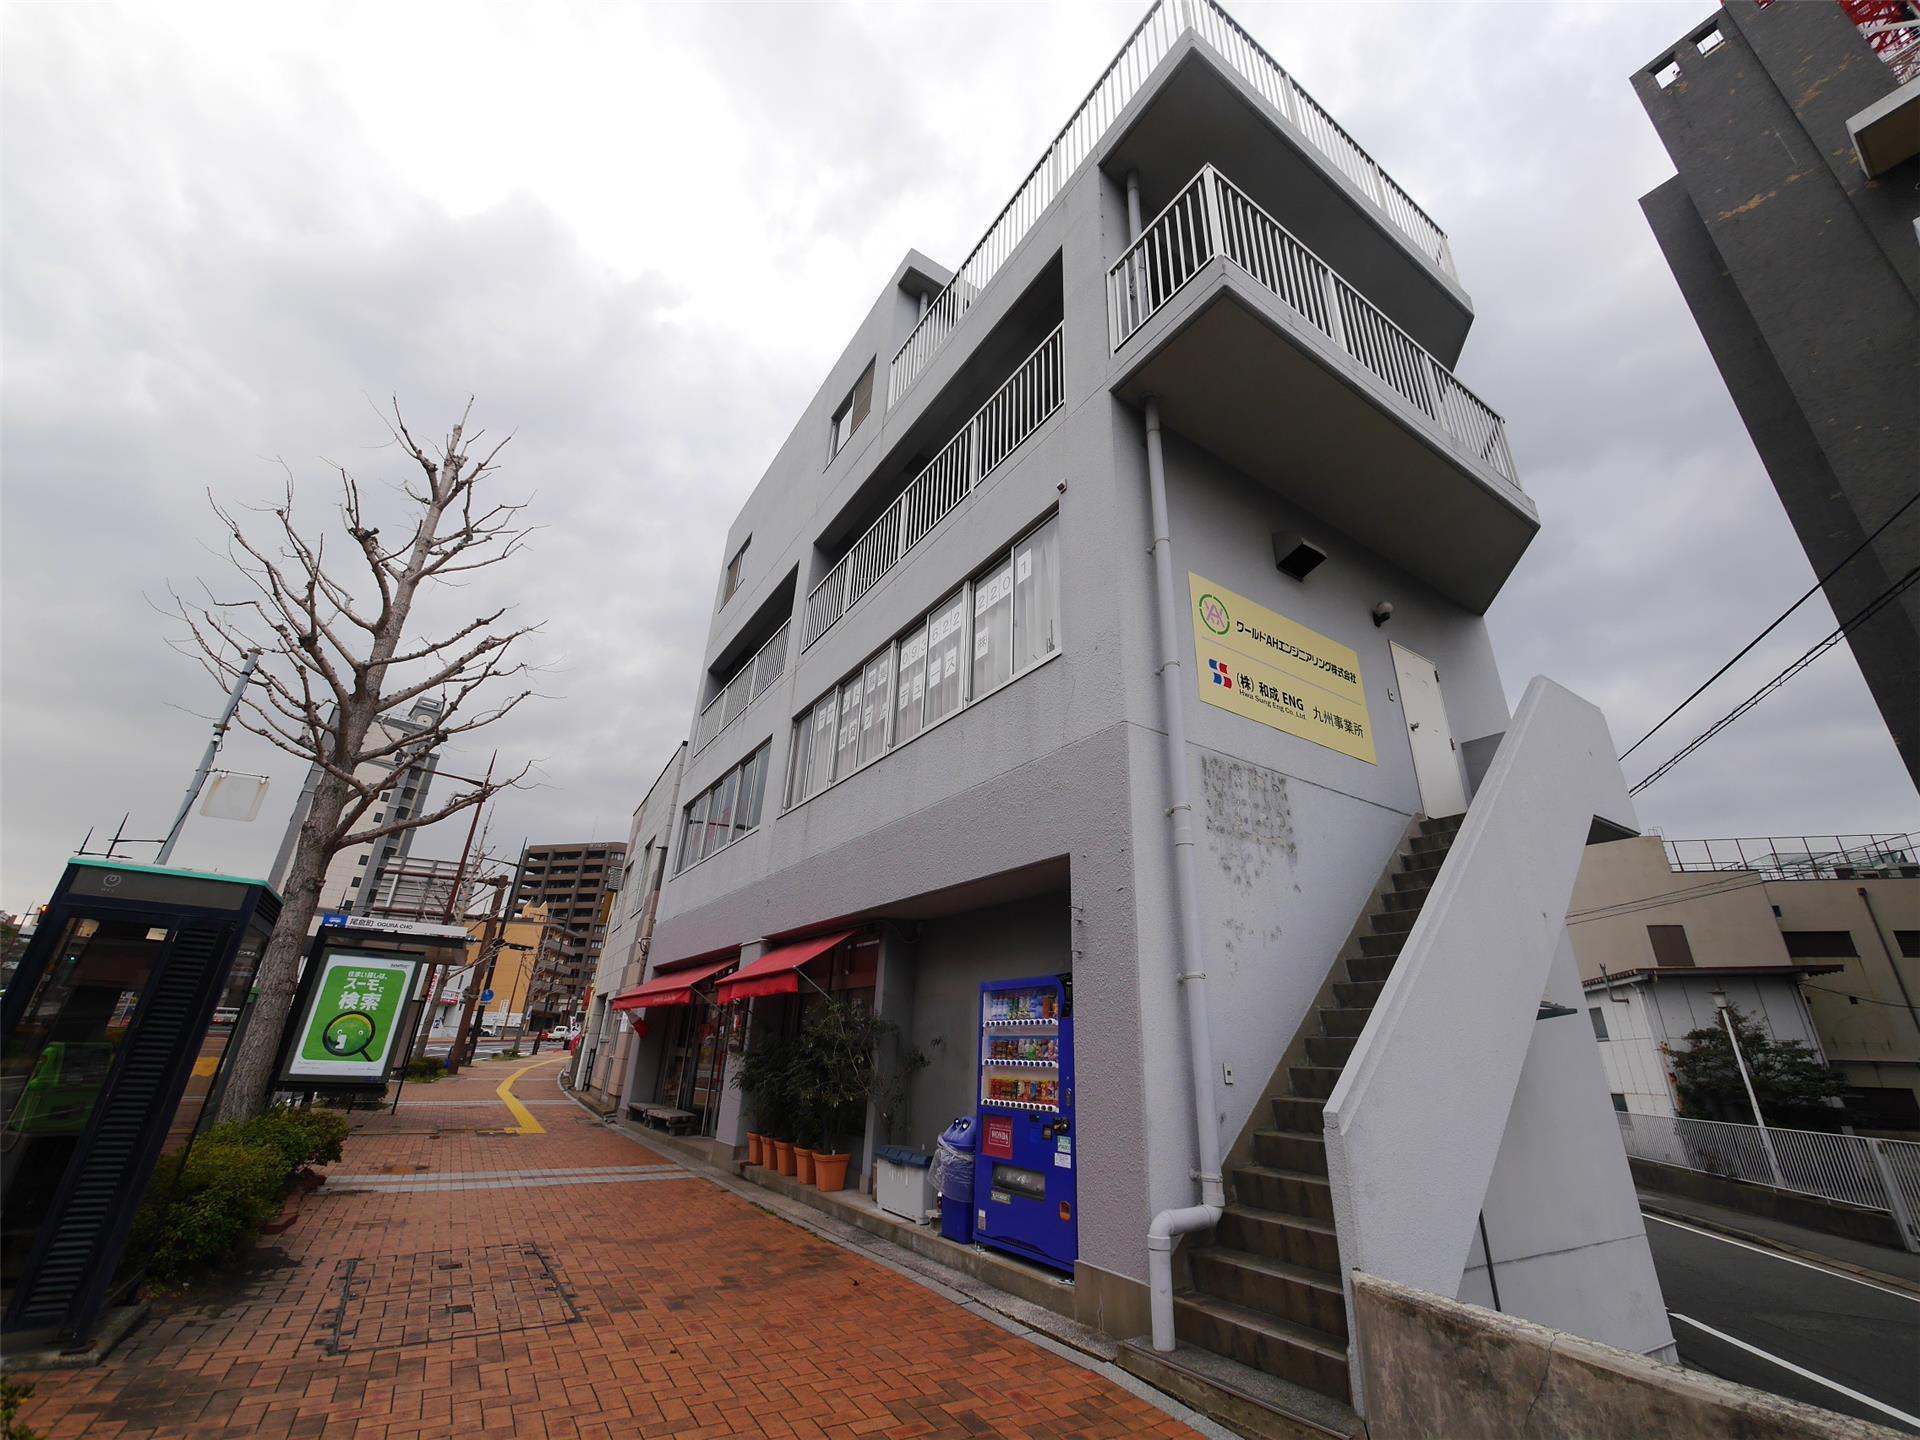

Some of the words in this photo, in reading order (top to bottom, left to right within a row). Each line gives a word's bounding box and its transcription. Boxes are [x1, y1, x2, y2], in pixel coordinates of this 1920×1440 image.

[1236, 620, 1357, 684] ワールドAHエンジニアリング株式会社
[1282, 691, 1304, 711] ENG
[1313, 706, 1364, 738] 九州事業所
[376, 921, 398, 929] OGURA
[338, 991, 382, 1012] 検索
